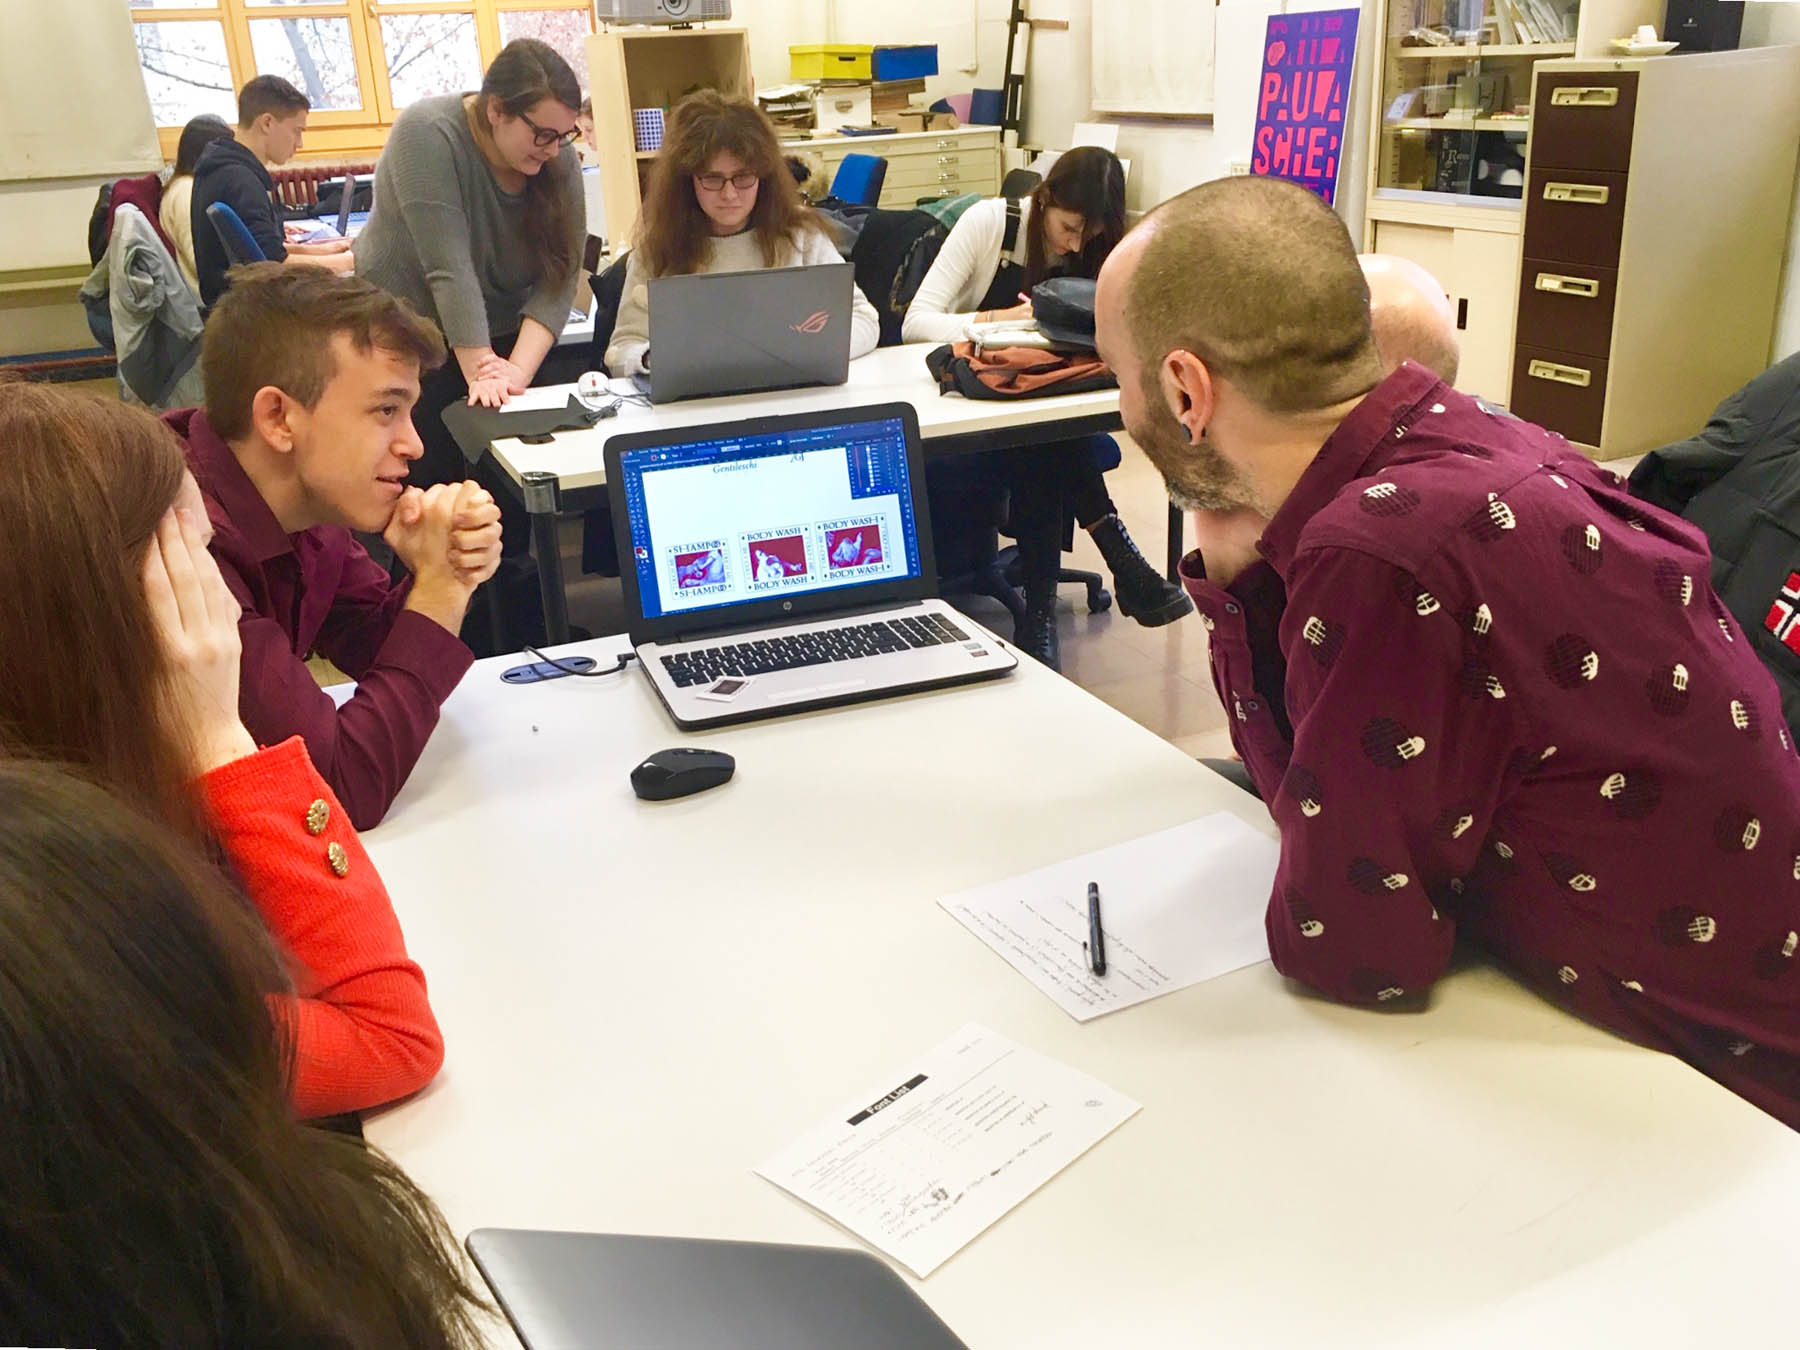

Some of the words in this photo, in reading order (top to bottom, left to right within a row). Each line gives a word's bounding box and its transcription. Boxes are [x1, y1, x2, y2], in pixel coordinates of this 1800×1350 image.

[712, 459, 758, 474] Gentileschi
[823, 519, 849, 531] BODY
[850, 515, 879, 527] WASH
[747, 530, 773, 541] BODY
[775, 526, 802, 538] WASH
[829, 568, 855, 579] BODY
[857, 563, 885, 575] WASH
[754, 580, 780, 592] BODY
[782, 575, 808, 587] WASH
[866, 1097, 891, 1114] Font
[888, 1085, 910, 1100] List
